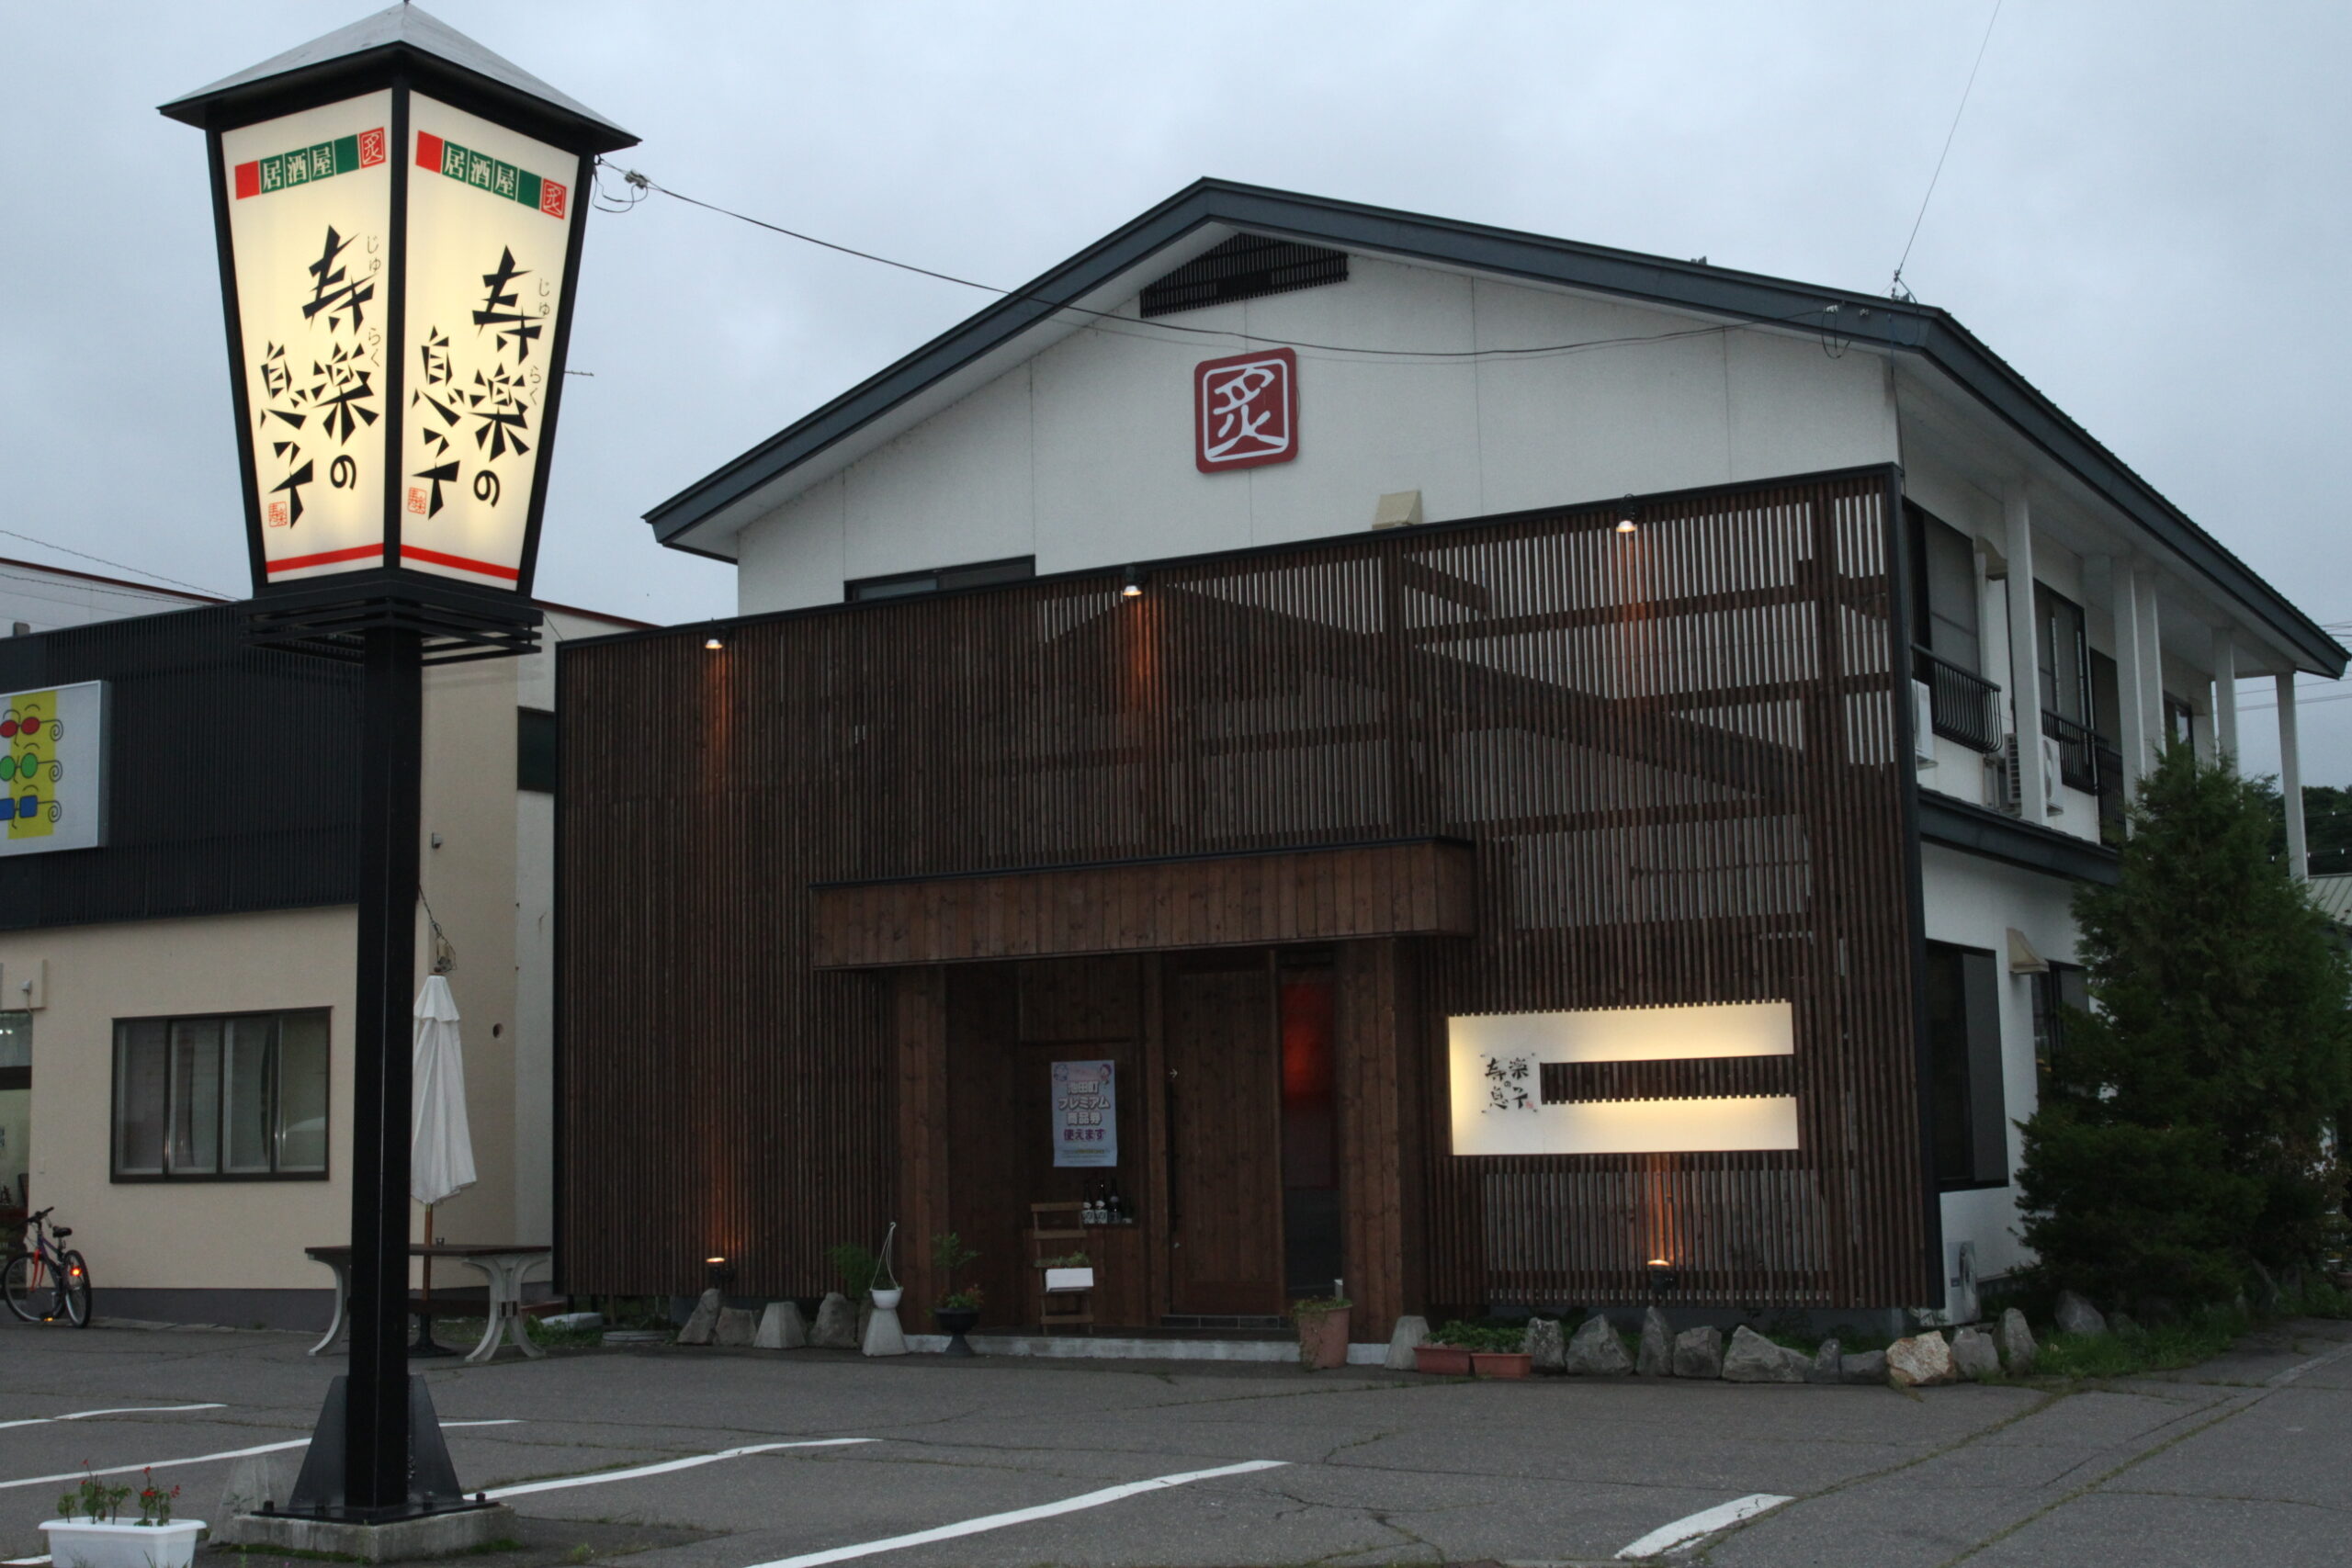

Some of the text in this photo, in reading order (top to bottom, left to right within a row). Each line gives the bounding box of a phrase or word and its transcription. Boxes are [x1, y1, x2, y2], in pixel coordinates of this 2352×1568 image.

[263, 146, 334, 191] 居酒屋
[445, 146, 514, 198] 居酒屋
[260, 340, 314, 530] 息子
[411, 324, 462, 521] 息子
[1058, 1096, 1110, 1110] プレミアム
[1067, 1111, 1102, 1125] 商品券
[1064, 1129, 1104, 1141] 使えます
